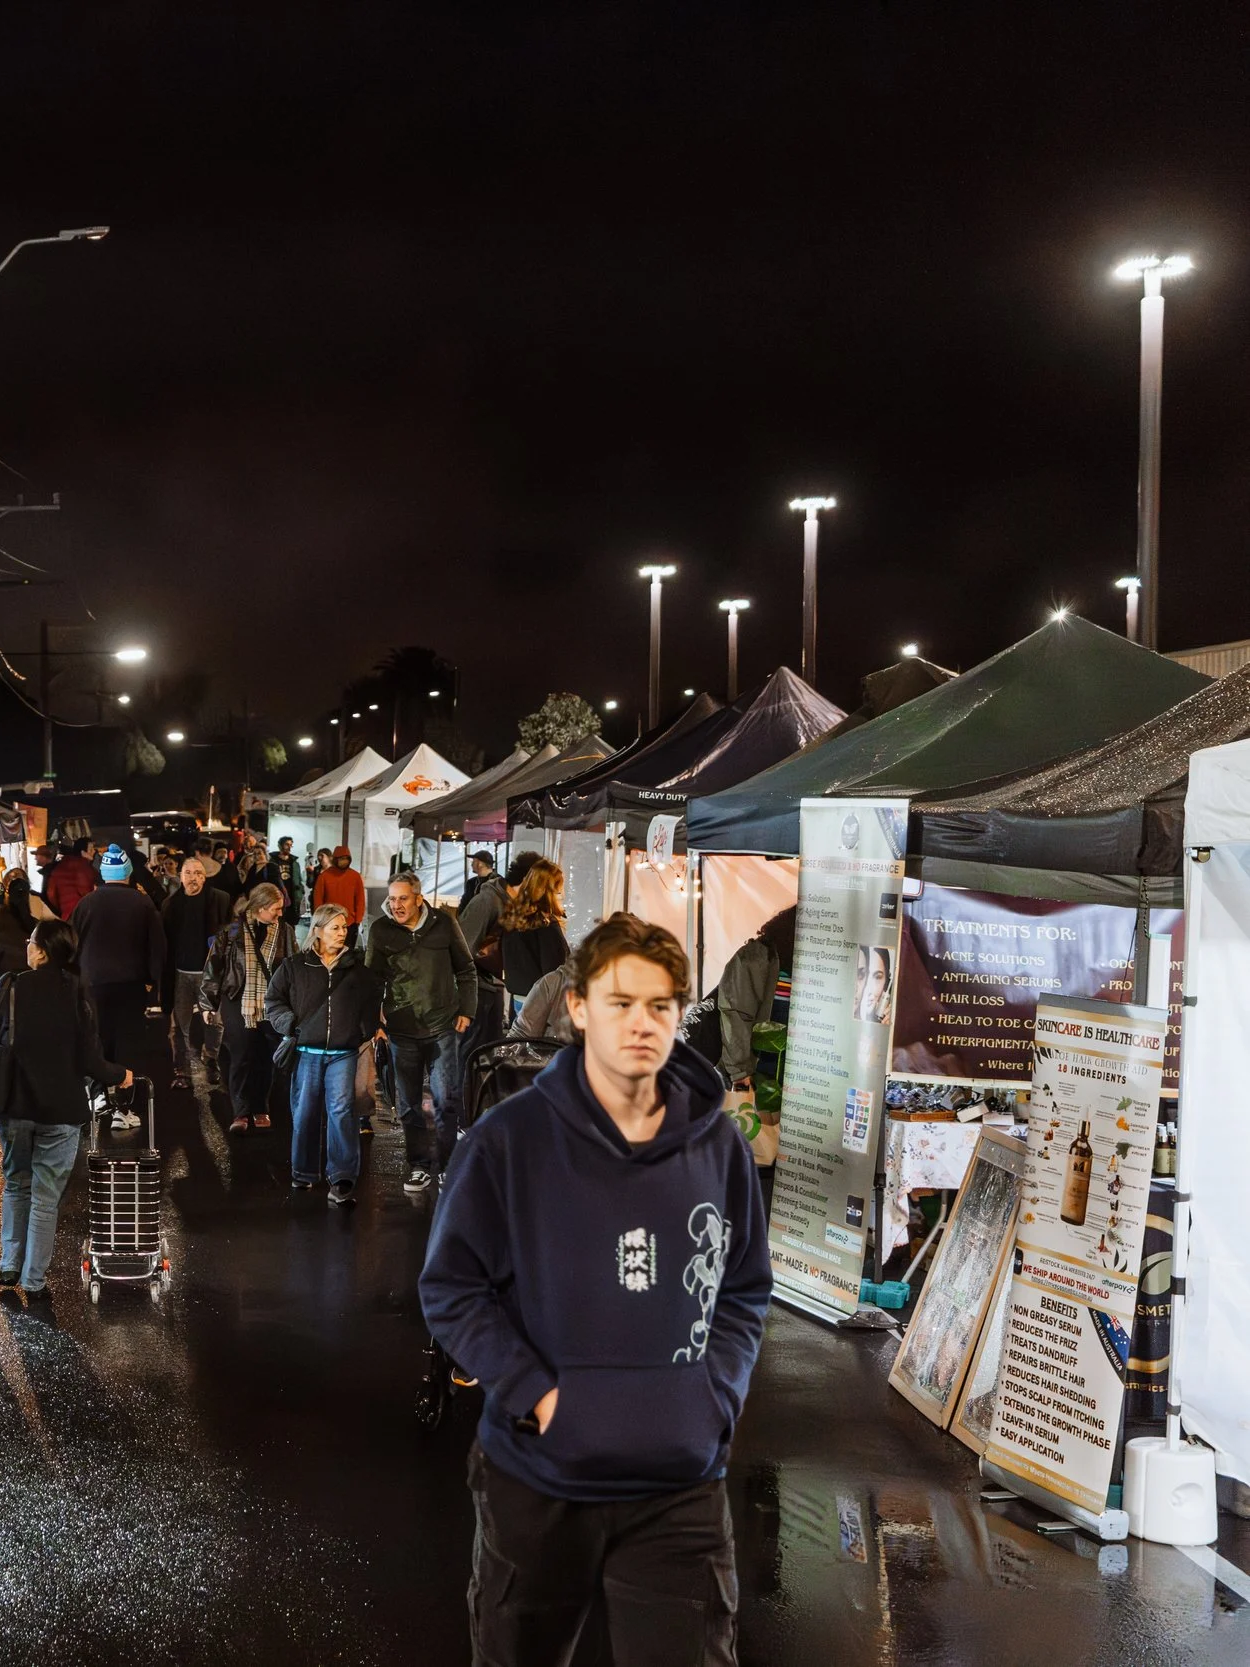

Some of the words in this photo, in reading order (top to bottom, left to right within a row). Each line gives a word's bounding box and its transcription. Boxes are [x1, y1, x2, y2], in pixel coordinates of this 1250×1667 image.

[638, 791, 665, 800] HEAVY
[666, 793, 688, 801] DUTY
[861, 862, 900, 875] FRAGRANCE
[923, 918, 1031, 939] TREATMENTS
[1036, 926, 1077, 941] FOR:
[942, 951, 975, 962] ACNE
[978, 953, 1046, 966] SOLUTIONS
[941, 972, 1011, 985] ANTI-AGING
[1013, 976, 1062, 988] SERUMS
[940, 993, 970, 1004] HAIR
[972, 995, 1005, 1007] LOSS
[938, 1014, 972, 1026] HEAD
[975, 1016, 993, 1027] TO
[996, 1018, 1021, 1028] TOE
[1037, 1018, 1082, 1037] SKINCARE
[1083, 1026, 1093, 1039] IS
[1095, 1027, 1160, 1050] HEALTHCARE
[936, 1034, 1036, 1050] HYPERPIGMENTA
[987, 1059, 1024, 1070] Where
[1057, 1063, 1068, 1073] 18
[1070, 1065, 1127, 1085] INGREDIENTS
[1072, 1053, 1092, 1065] HAIR
[1094, 1057, 1130, 1072] GROWTH
[1132, 1065, 1148, 1076] AID
[770, 1249, 803, 1273] ANT-MADE
[803, 1265, 809, 1275] &
[809, 1265, 820, 1279] NO
[819, 1270, 859, 1296] FRAGRANCE
[1023, 1264, 1033, 1274] WE
[1033, 1267, 1049, 1279] SHIP
[1048, 1271, 1075, 1289] AROUND
[1075, 1280, 1087, 1292] THE
[1087, 1284, 1110, 1300] WORLD
[1101, 1279, 1127, 1293] afterpay
[1013, 1304, 1029, 1317] NON
[1029, 1308, 1058, 1327] GREASY
[1058, 1319, 1082, 1337] SERUM
[1040, 1296, 1078, 1319] BENEFITS
[1011, 1318, 1044, 1337] REDUCES
[1044, 1329, 1059, 1342] THE
[1058, 1336, 1078, 1351] FRIZZ
[1091, 1309, 1102, 1329] MADE
[1103, 1338, 1123, 1372] AUSTRALIA
[1010, 1334, 1037, 1351] TREATS
[1038, 1344, 1079, 1367] DANDRUFF
[1008, 1349, 1038, 1367] REPAIRS
[1038, 1360, 1068, 1379] BRITTLE
[1068, 1373, 1086, 1388] HAIR
[1006, 1364, 1040, 1386] REDUCES
[1040, 1378, 1059, 1393] HAIR
[1059, 1386, 1097, 1409] SHEDDING
[1004, 1380, 1028, 1398] STOPS
[1028, 1389, 1052, 1406] SCALP
[1051, 1400, 1073, 1417] FROM
[1073, 1407, 1105, 1431] ITCHING
[1002, 1411, 1034, 1433] LEAVE-IN
[1034, 1425, 1060, 1445] SERUM
[1003, 1395, 1036, 1418] EXTENDS
[1036, 1409, 1051, 1422] THE
[1051, 1416, 1082, 1438] GROWTH
[1082, 1431, 1111, 1451] PHASE
[1000, 1427, 1018, 1442] EASY
[1017, 1436, 1065, 1465] APPLICATION
